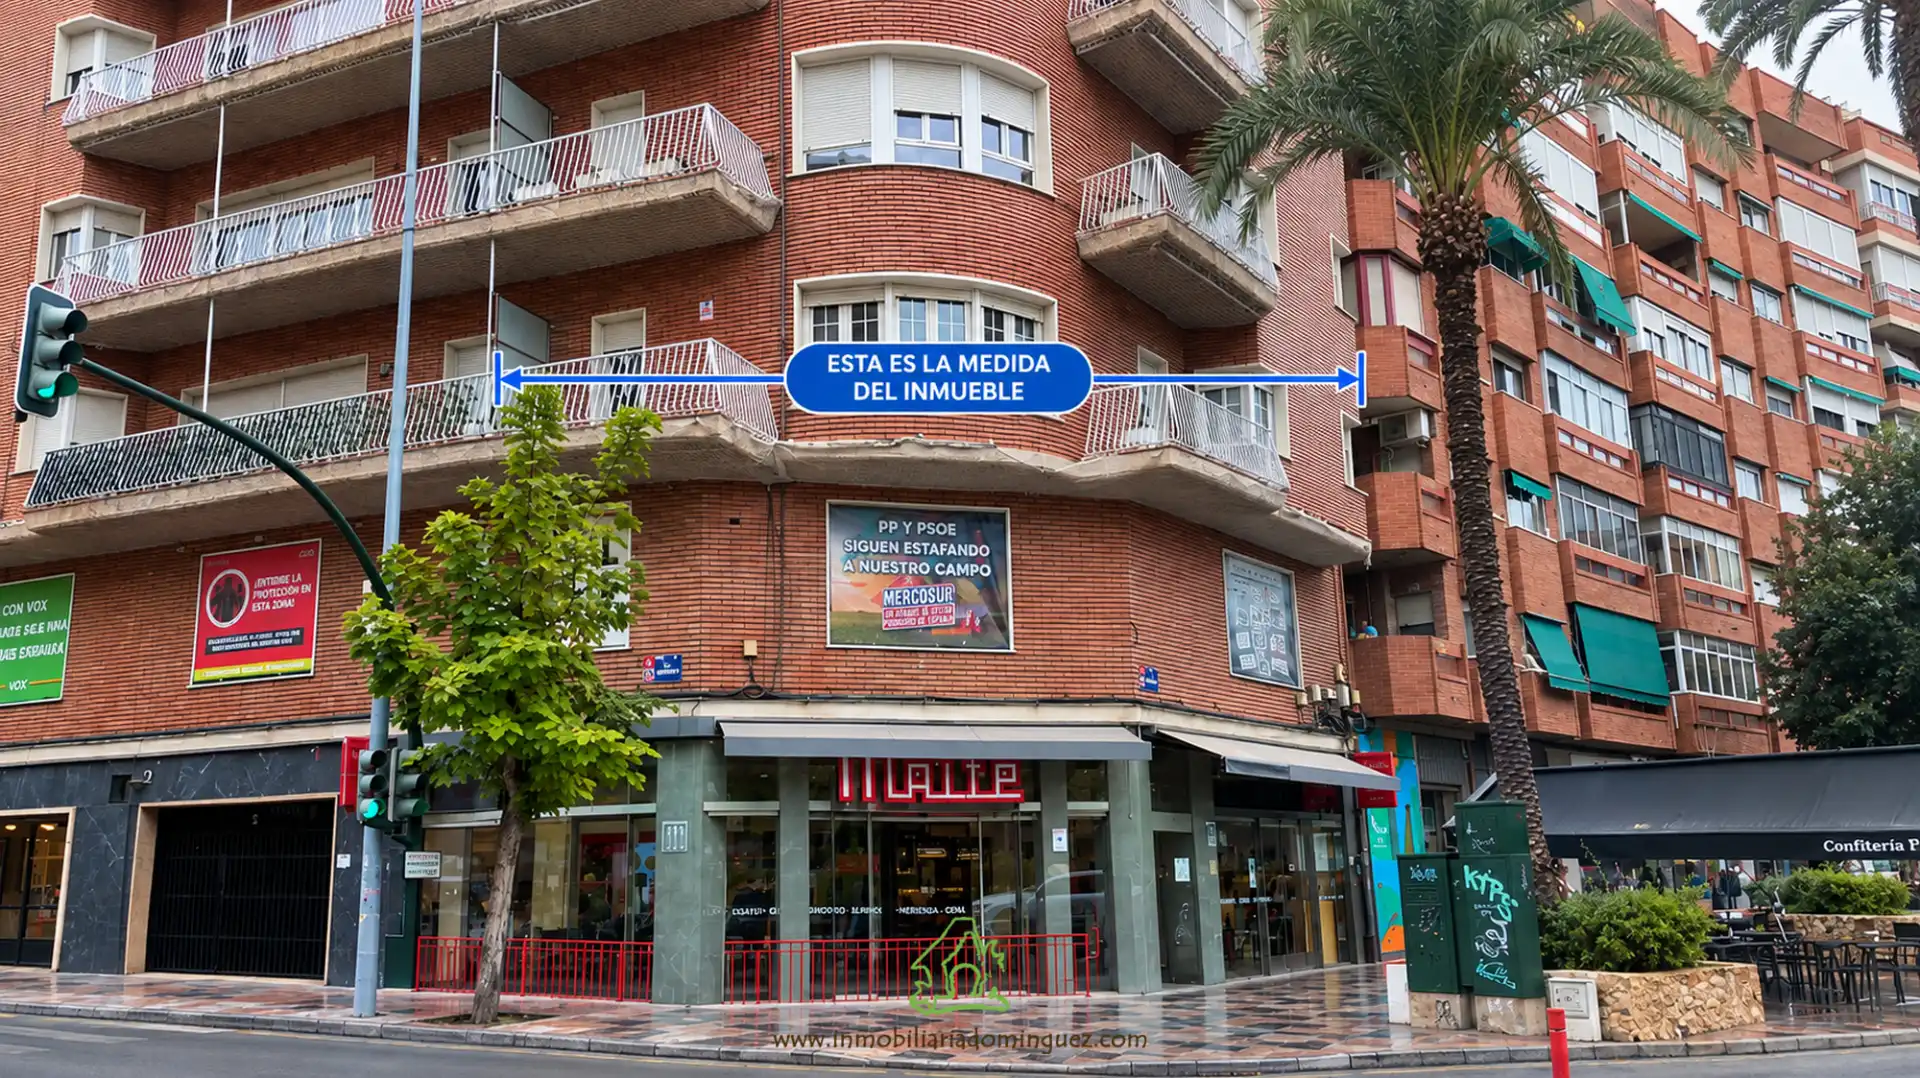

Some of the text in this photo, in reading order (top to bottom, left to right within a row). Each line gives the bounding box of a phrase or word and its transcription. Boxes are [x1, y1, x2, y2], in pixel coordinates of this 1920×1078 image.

[878, 520, 956, 536] PP Y PSOE
[843, 539, 990, 557] SIGUEN ESTAFANDO
[843, 560, 991, 577] A NUESTRO CAMPO
[883, 586, 953, 606] MERCOSUR
[2, 599, 48, 616] CON VOX
[252, 602, 271, 612] ESTA
[9, 679, 28, 691] VOX
[143, 769, 153, 784] 2
[1823, 838, 1905, 852] Confitería
